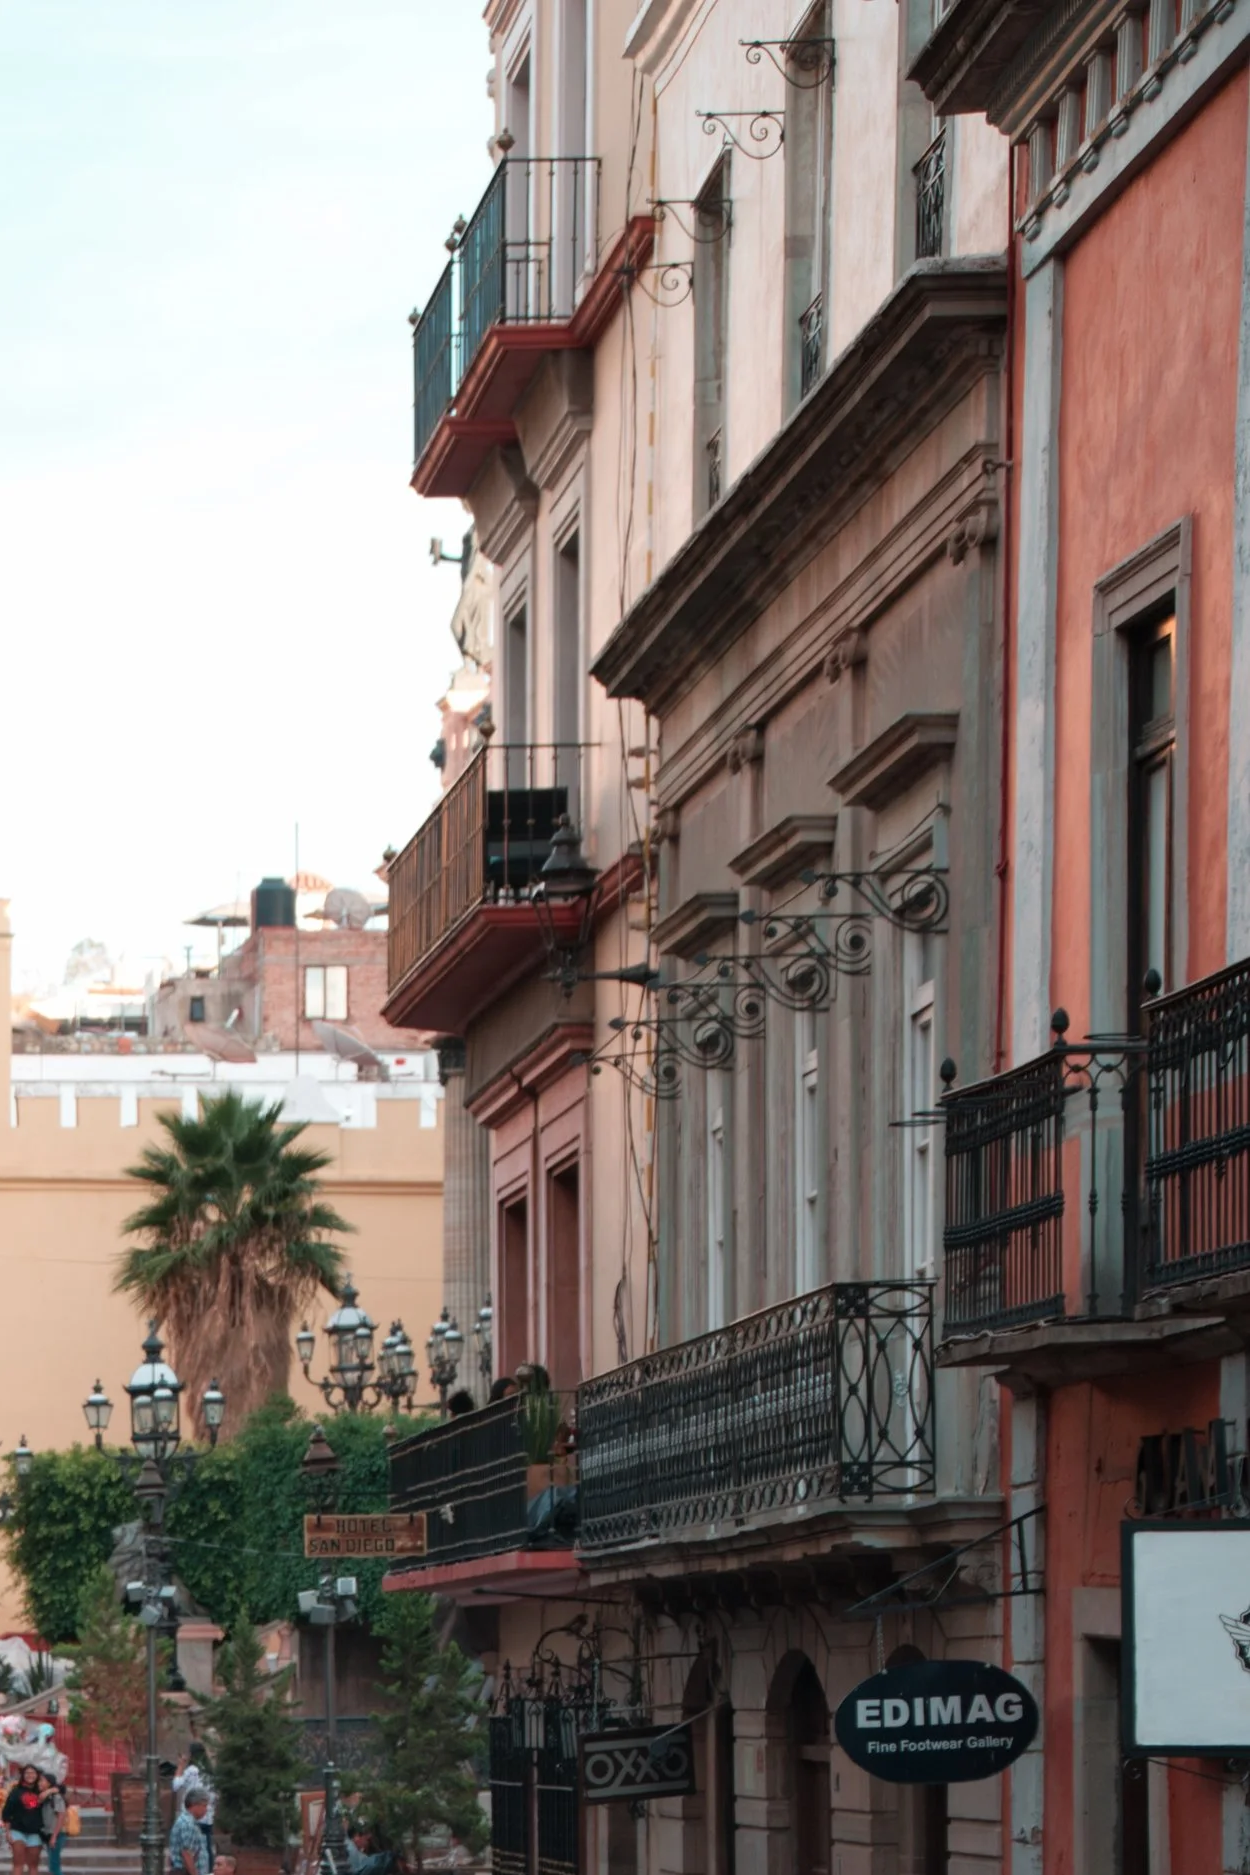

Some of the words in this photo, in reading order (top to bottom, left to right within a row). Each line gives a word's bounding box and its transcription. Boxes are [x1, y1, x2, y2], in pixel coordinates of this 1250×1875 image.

[336, 1519, 392, 1533] HOTEL
[310, 1539, 340, 1552] SAN
[346, 1539, 395, 1553] DIEGO
[856, 1692, 1024, 1729] EDIMAG
[867, 1740, 897, 1754] Fine
[900, 1737, 964, 1752] Footwear
[966, 1735, 1014, 1750] Gallery
[585, 1747, 688, 1788] OXXO
